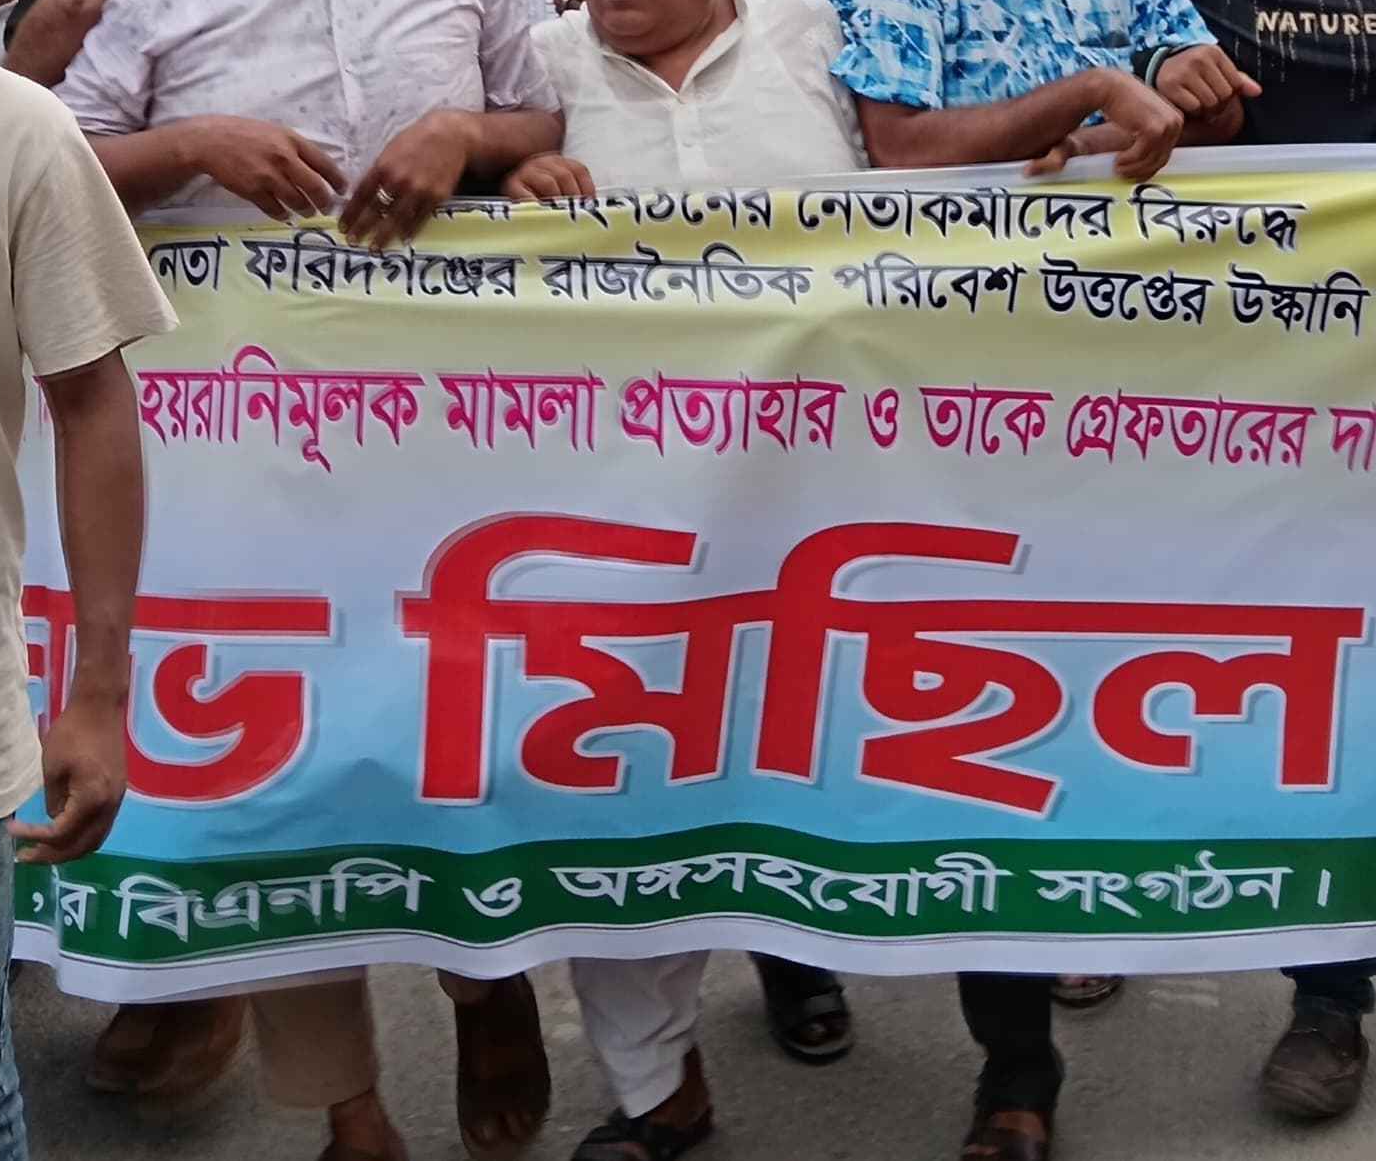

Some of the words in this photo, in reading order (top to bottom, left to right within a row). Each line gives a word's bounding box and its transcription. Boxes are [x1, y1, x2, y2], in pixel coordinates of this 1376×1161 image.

[1129, 183, 1306, 252] বিরুদ্ধে
[242, 227, 527, 299] ফরিদগঞ্জের
[540, 240, 814, 305] রাজনৈতিক
[833, 250, 1028, 315] পরিবেশ
[1039, 252, 1215, 326] উত্তপ্তের
[1226, 263, 1372, 338] উস্কানি
[437, 362, 608, 453] মামলা
[618, 367, 848, 459] প্রত্যাহার
[863, 386, 901, 450] ও
[919, 382, 1056, 458] তাকে
[1065, 387, 1318, 466] গ্রেফতারের
[393, 509, 1369, 820] মিছিল
[115, 854, 434, 943] বিএনপি
[461, 875, 524, 920] ও
[550, 850, 1014, 917] অঙ্গসহযোগী
[1031, 848, 1294, 918] সংগঠন
